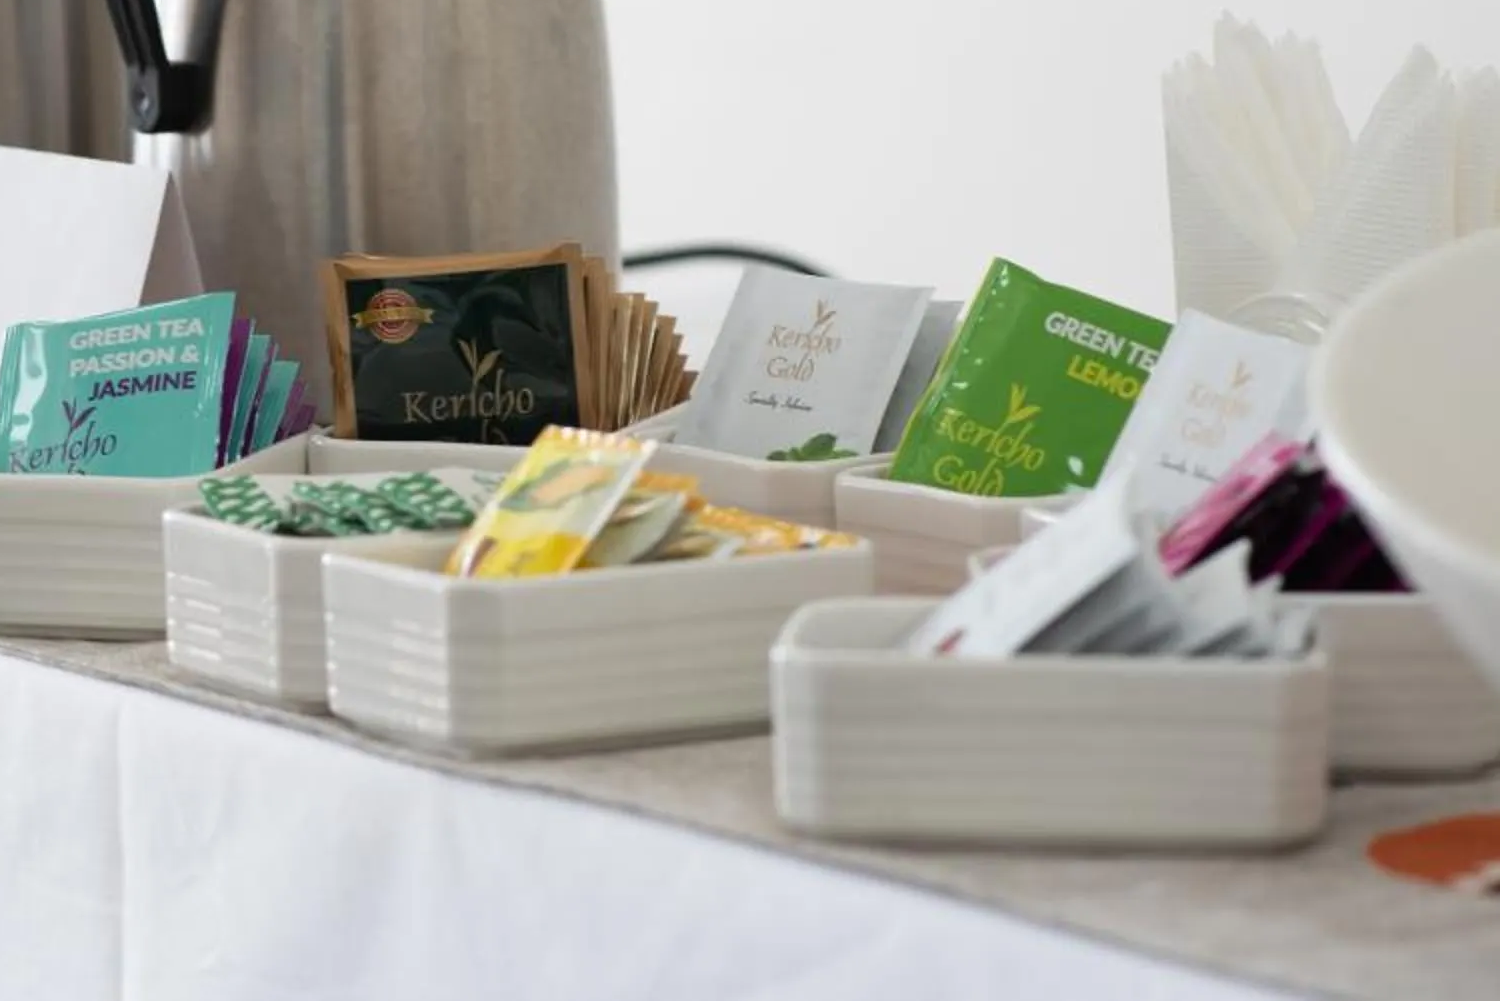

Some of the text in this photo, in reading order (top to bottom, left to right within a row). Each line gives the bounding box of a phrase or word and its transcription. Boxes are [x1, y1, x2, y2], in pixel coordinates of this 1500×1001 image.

[68, 317, 205, 350] GREEN TEA
[1044, 311, 1162, 374] GREEN TE
[68, 344, 200, 377] PASSION &
[1066, 354, 1141, 399] LEMO
[88, 370, 197, 402] JASMINE
[401, 367, 535, 424] Kericho
[9, 420, 118, 474] Kericho
[934, 406, 1045, 472] Kericho
[932, 454, 1005, 497] Gold
